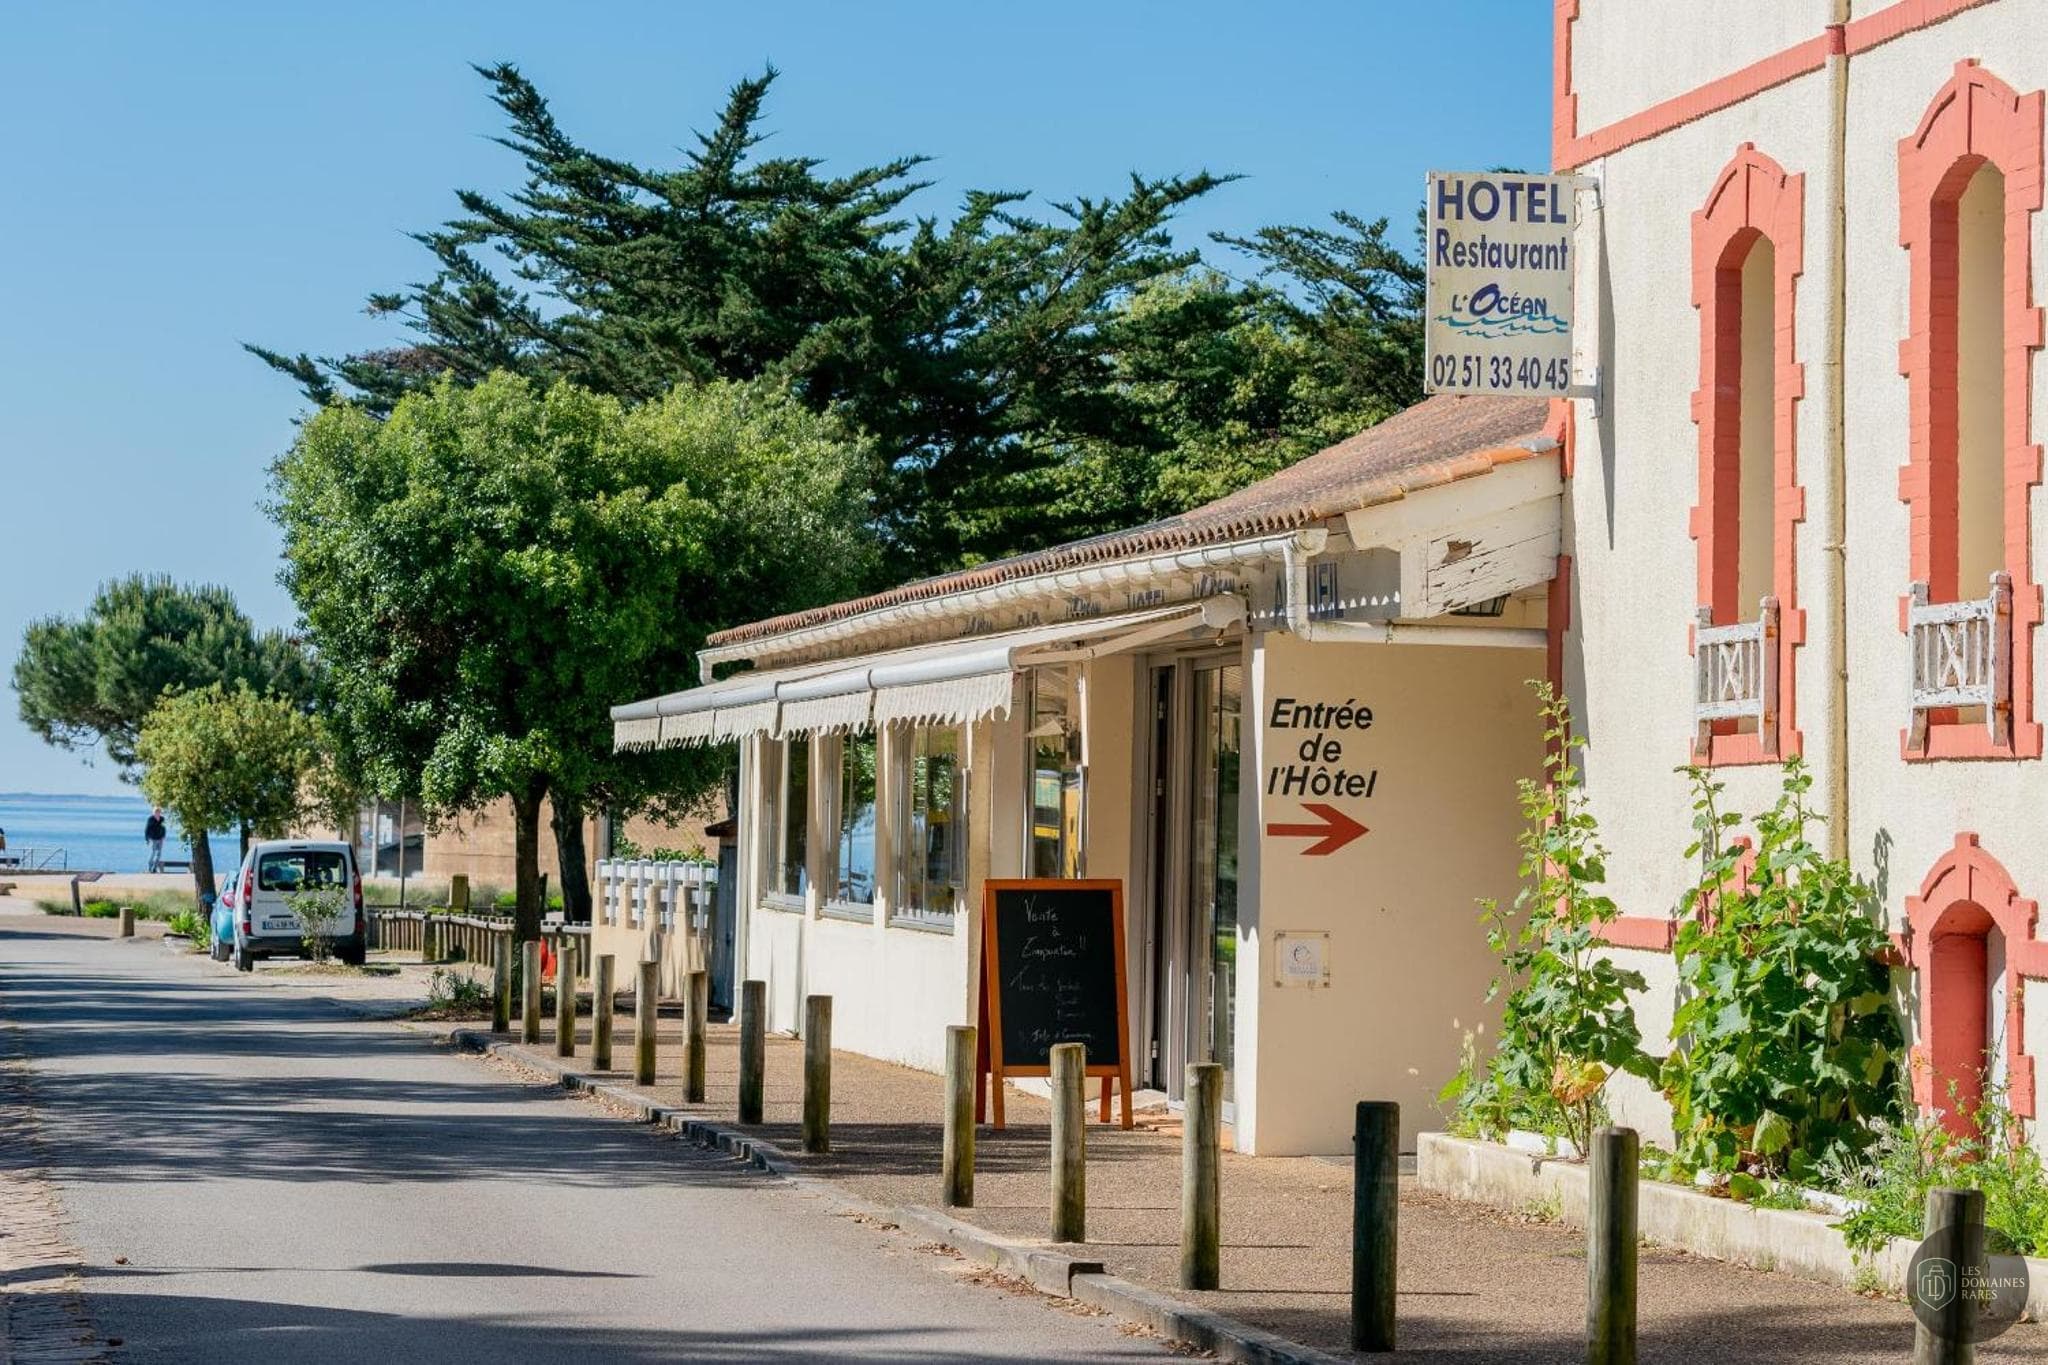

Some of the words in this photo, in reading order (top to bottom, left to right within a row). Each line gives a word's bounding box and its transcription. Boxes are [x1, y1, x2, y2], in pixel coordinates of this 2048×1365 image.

[1437, 179, 1567, 224] HOTEL
[1435, 228, 1568, 271] Restaurant
[1433, 354, 1457, 387] 02
[1462, 355, 1482, 388] 51
[1490, 356, 1512, 389] 33
[1517, 357, 1541, 390] 40
[1545, 358, 1569, 391] 45
[1269, 698, 1374, 730] Entrée
[1299, 733, 1342, 763] de
[1267, 765, 1378, 798] l'Hôtel
[1024, 895, 1059, 922] Vente
